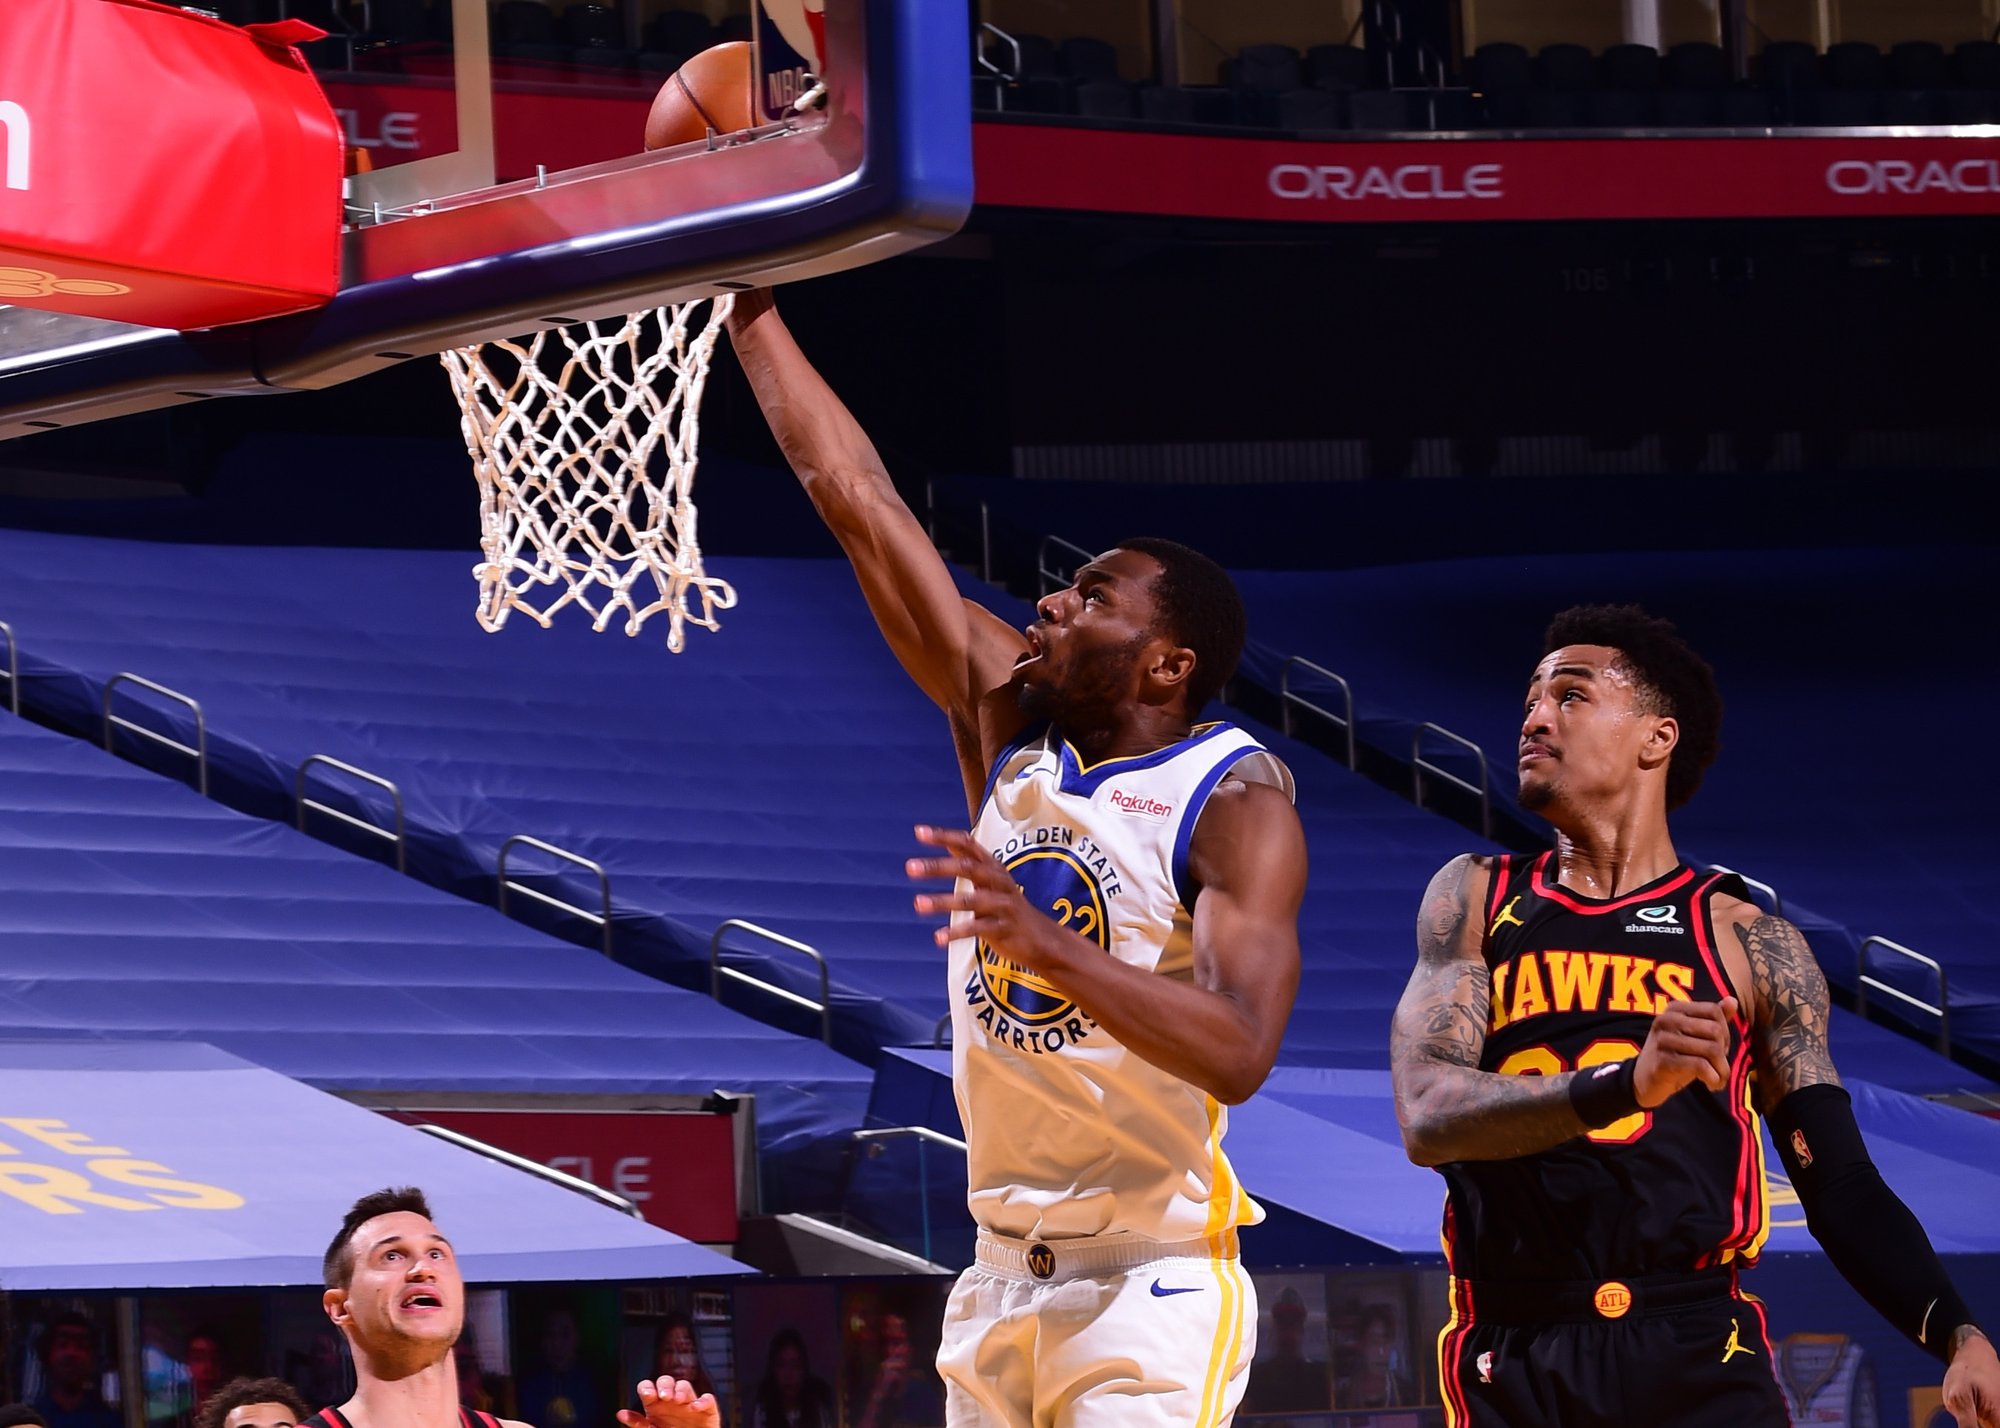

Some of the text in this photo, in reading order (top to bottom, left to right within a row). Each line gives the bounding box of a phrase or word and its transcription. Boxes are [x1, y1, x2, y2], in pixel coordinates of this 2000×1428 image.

[1267, 163, 1504, 200] ORACLE
[1561, 267, 1609, 292] 106
[1110, 789, 1172, 817] Rakuten
[1078, 836, 1122, 899] STATE
[1625, 923, 1685, 935] sharecare
[1028, 1253, 1053, 1276] W
[1600, 1293, 1627, 1307] ATL
